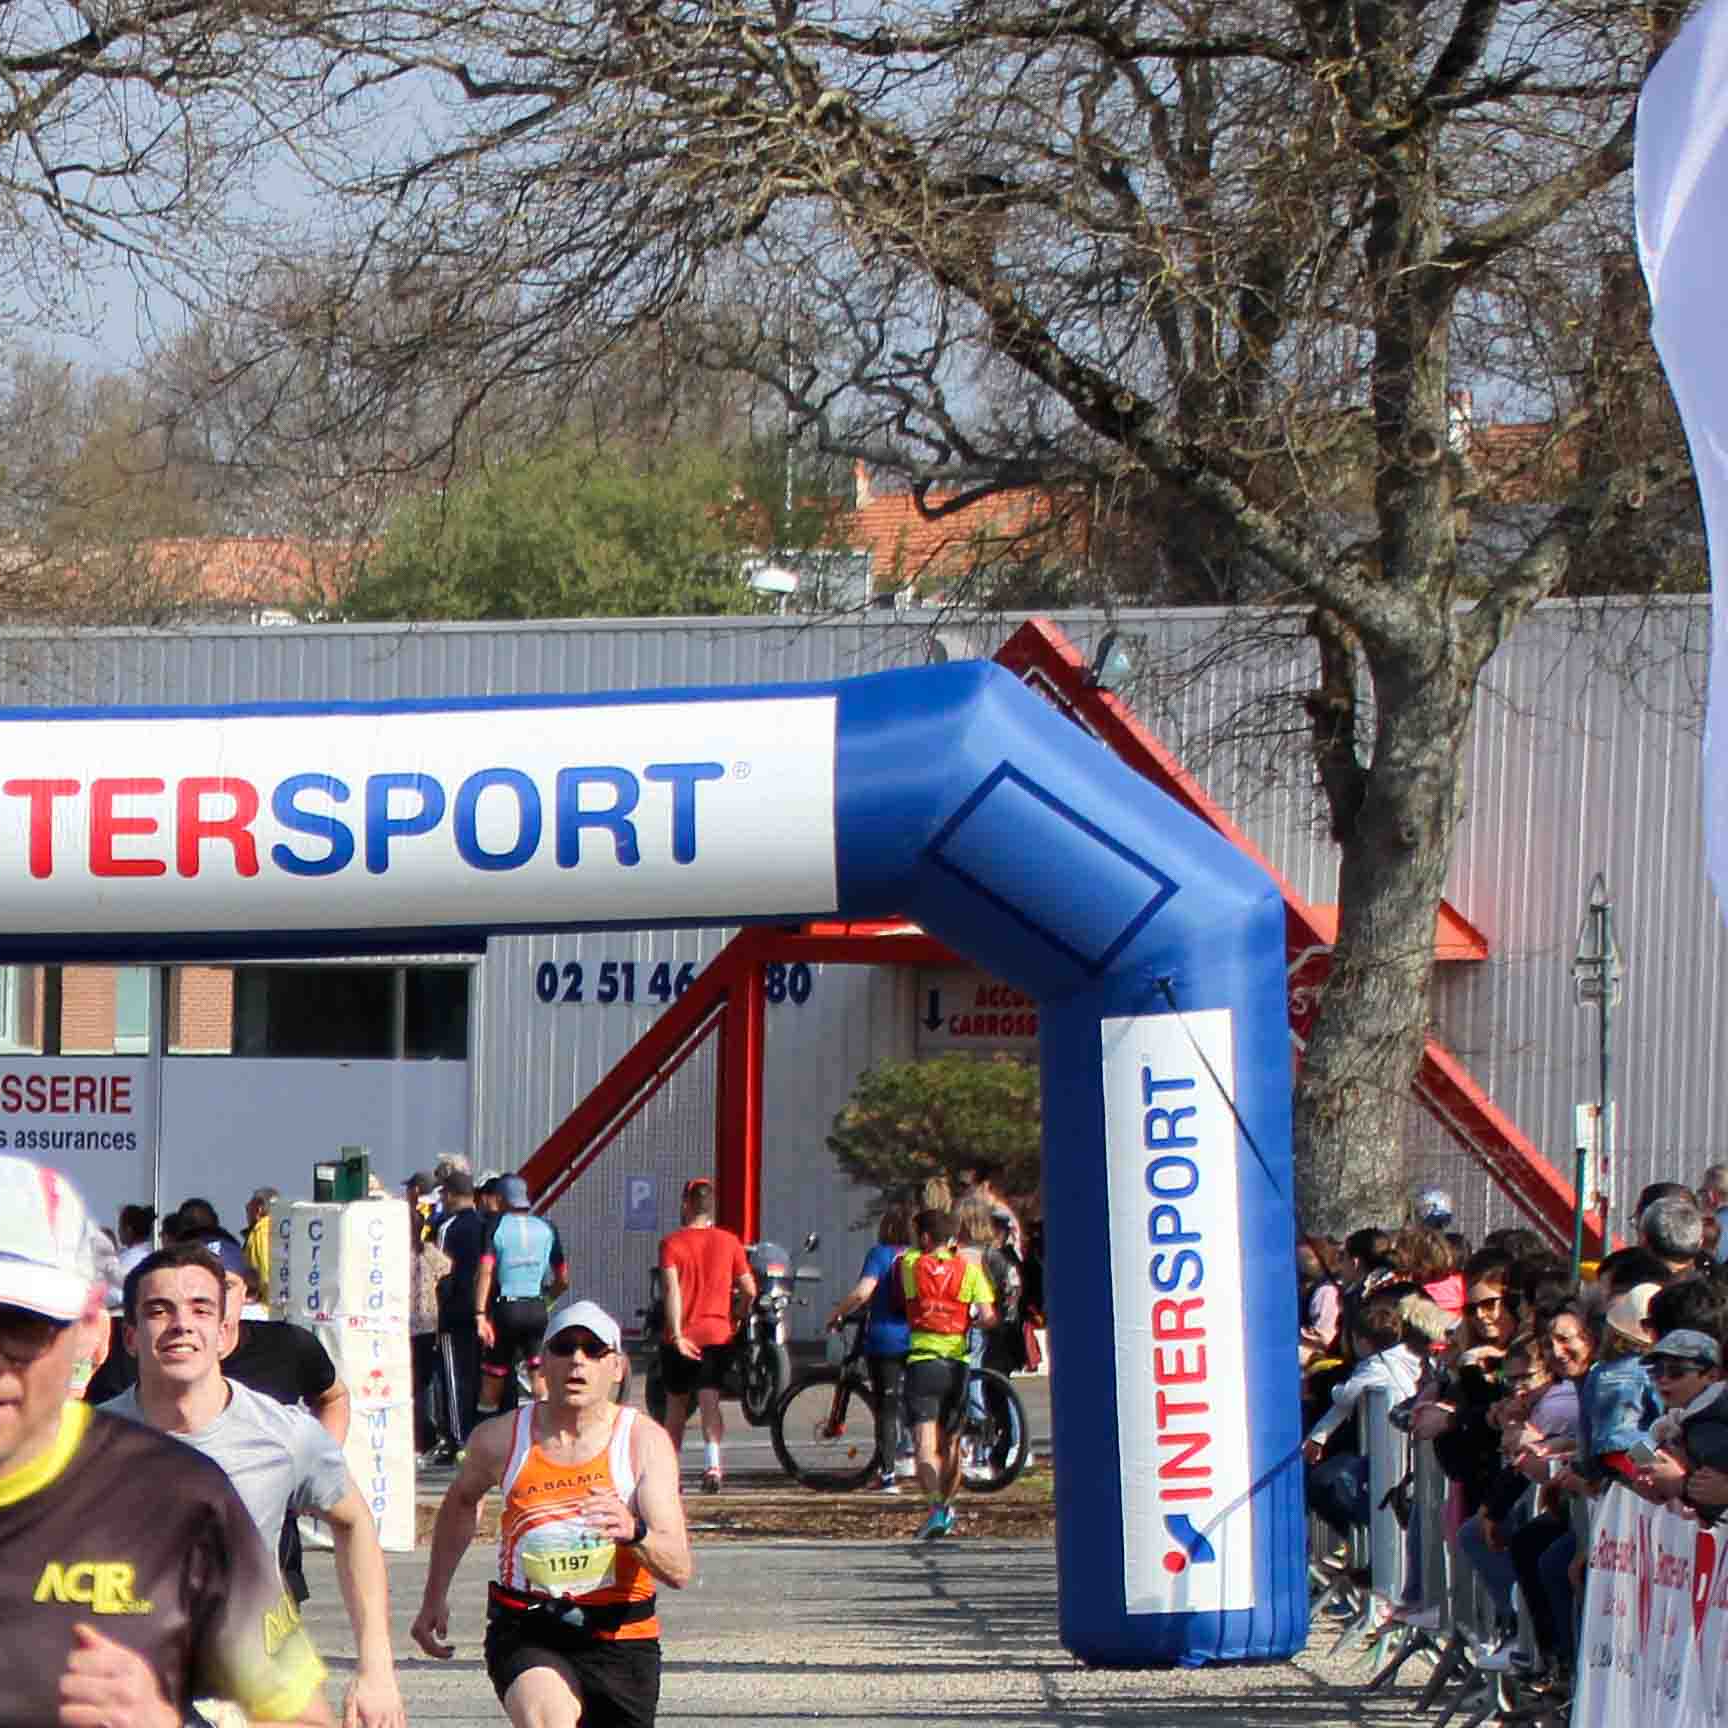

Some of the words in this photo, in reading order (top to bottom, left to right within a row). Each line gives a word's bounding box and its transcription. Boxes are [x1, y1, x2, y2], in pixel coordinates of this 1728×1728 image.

[535, 962, 584, 1004] 02
[597, 962, 635, 1003] 51
[14, 1128, 137, 1151] assurances
[1140, 1066, 1214, 1503] INTERSPORT
[549, 1555, 590, 1574] 1197
